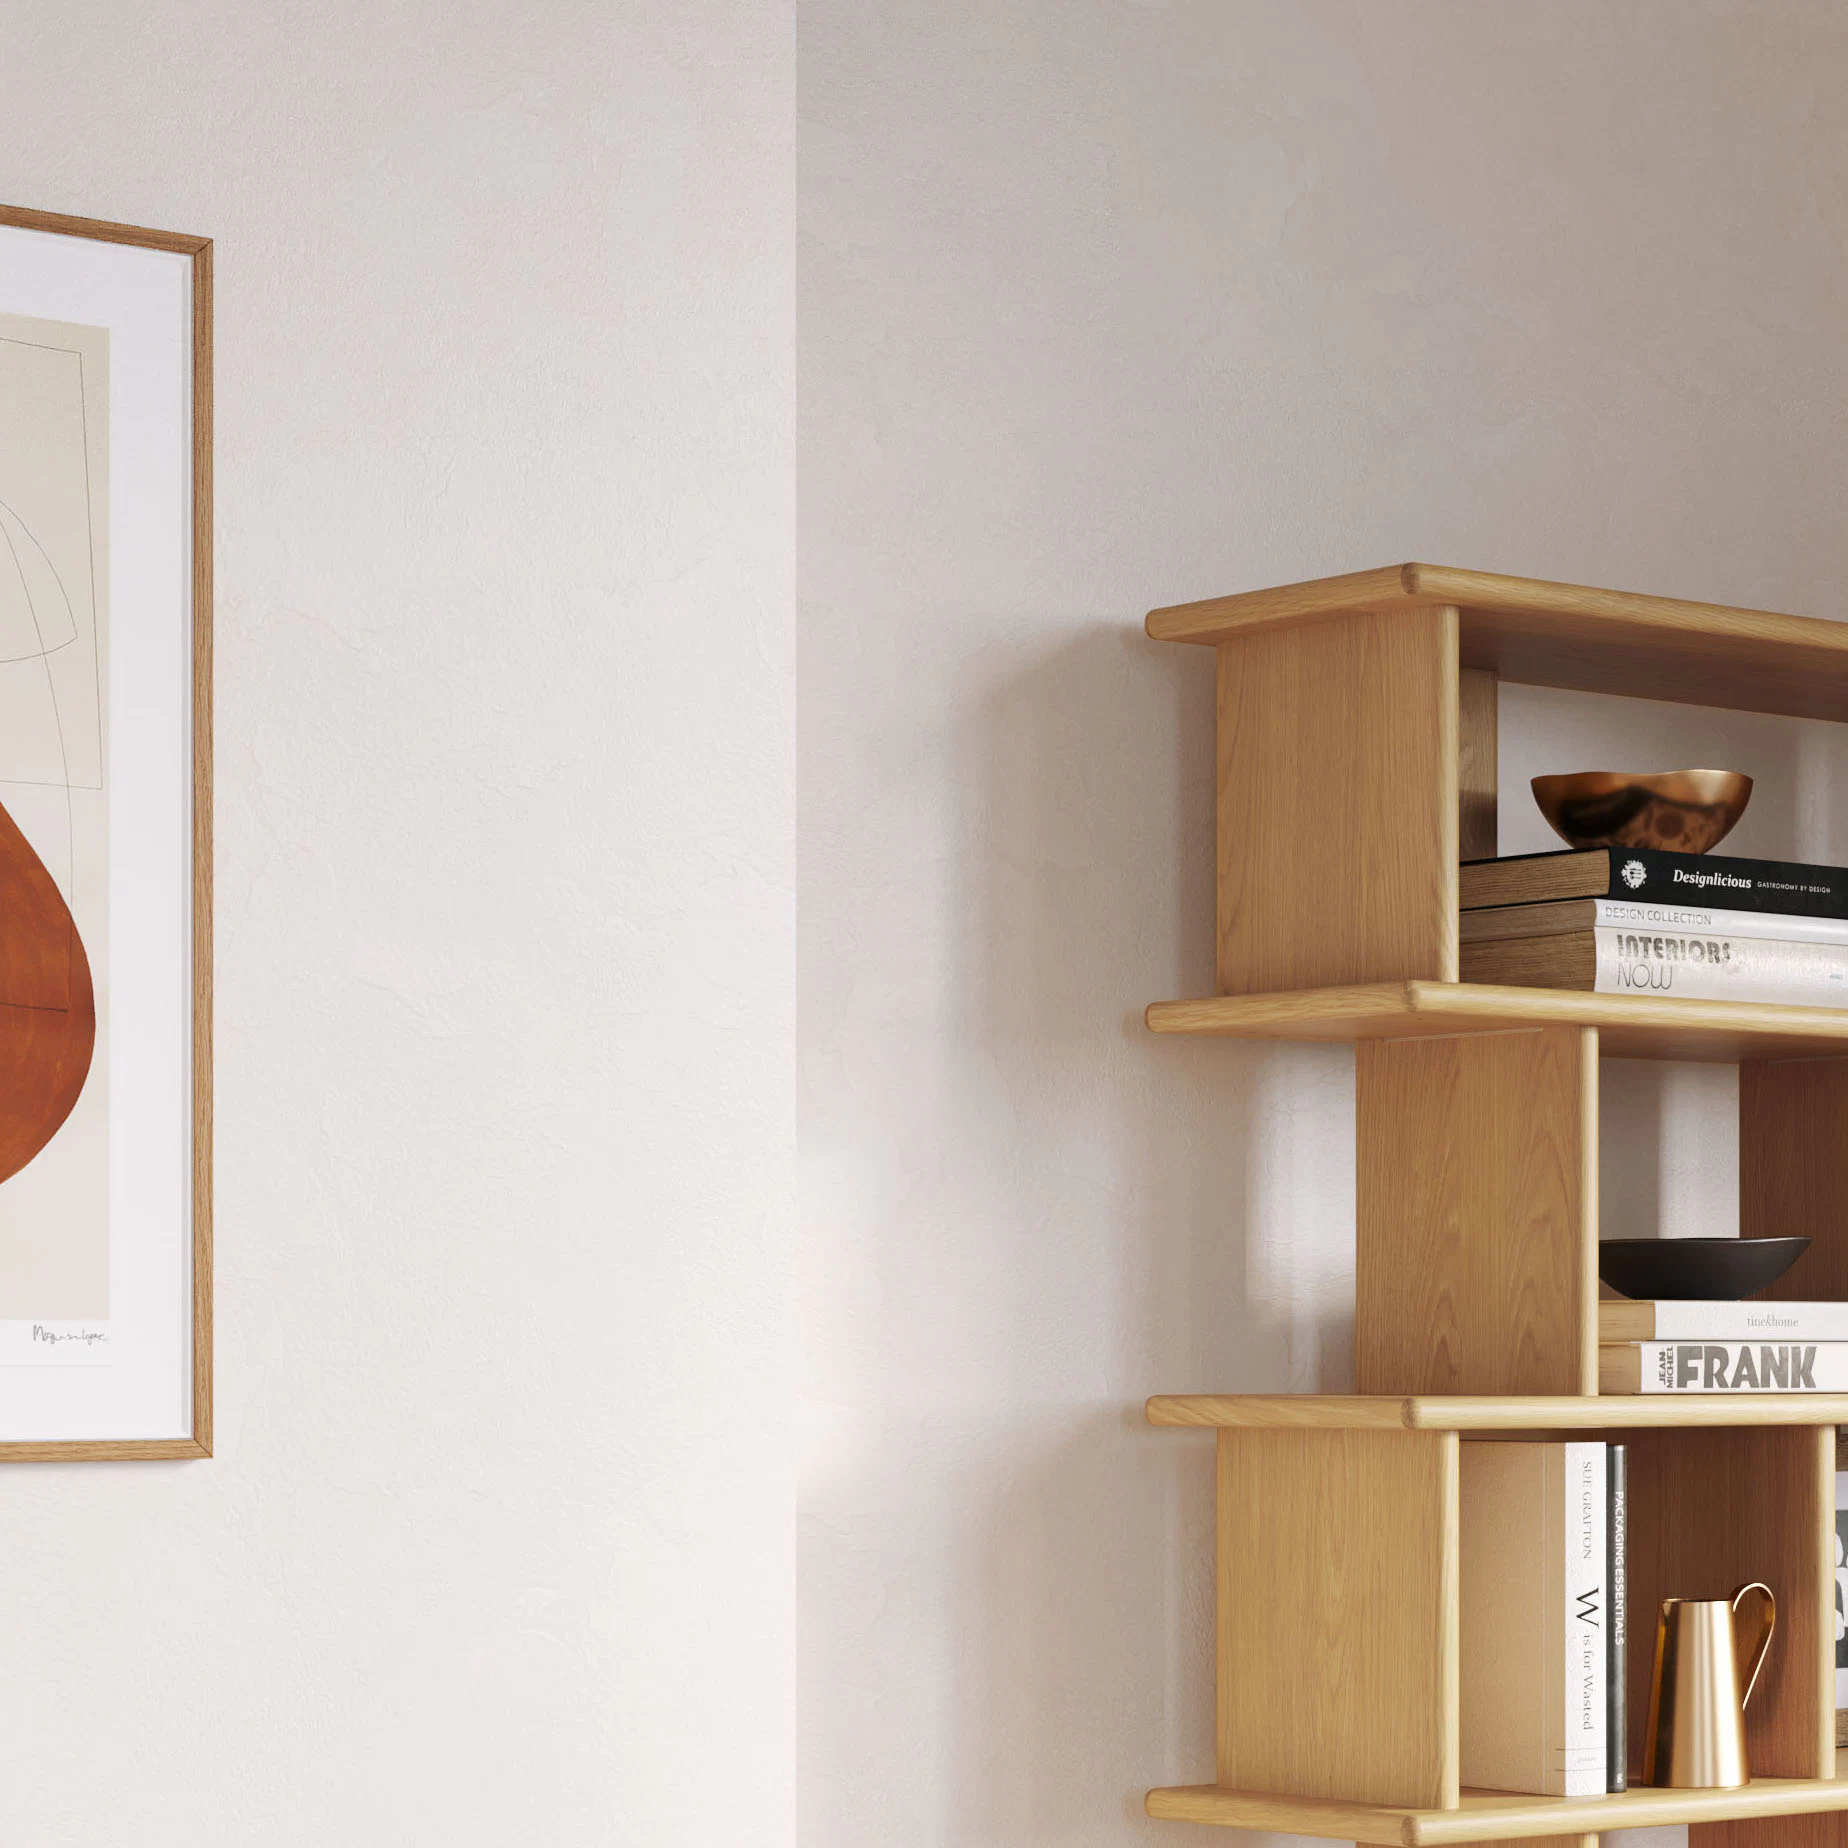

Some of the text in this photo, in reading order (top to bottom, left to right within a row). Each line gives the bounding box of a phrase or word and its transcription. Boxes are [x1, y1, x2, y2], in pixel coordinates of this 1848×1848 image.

[1673, 869, 1752, 888] Designlicious
[1757, 881, 1798, 891] GASTRONOMY
[1808, 886, 1831, 894] DESIGN
[1605, 906, 1712, 925] DESIGN COLLECTION
[1617, 934, 1730, 963] INTERIORS
[1617, 962, 1673, 989] NOW
[1666, 1345, 1674, 1388] MICHEL
[1676, 1345, 1818, 1389] FRANK
[1583, 1461, 1592, 1559] SUE GRAFTON
[1614, 1491, 1625, 1646] PACKAGING ESSENTIALS
[1576, 1586, 1599, 1730] W is for Wasted
